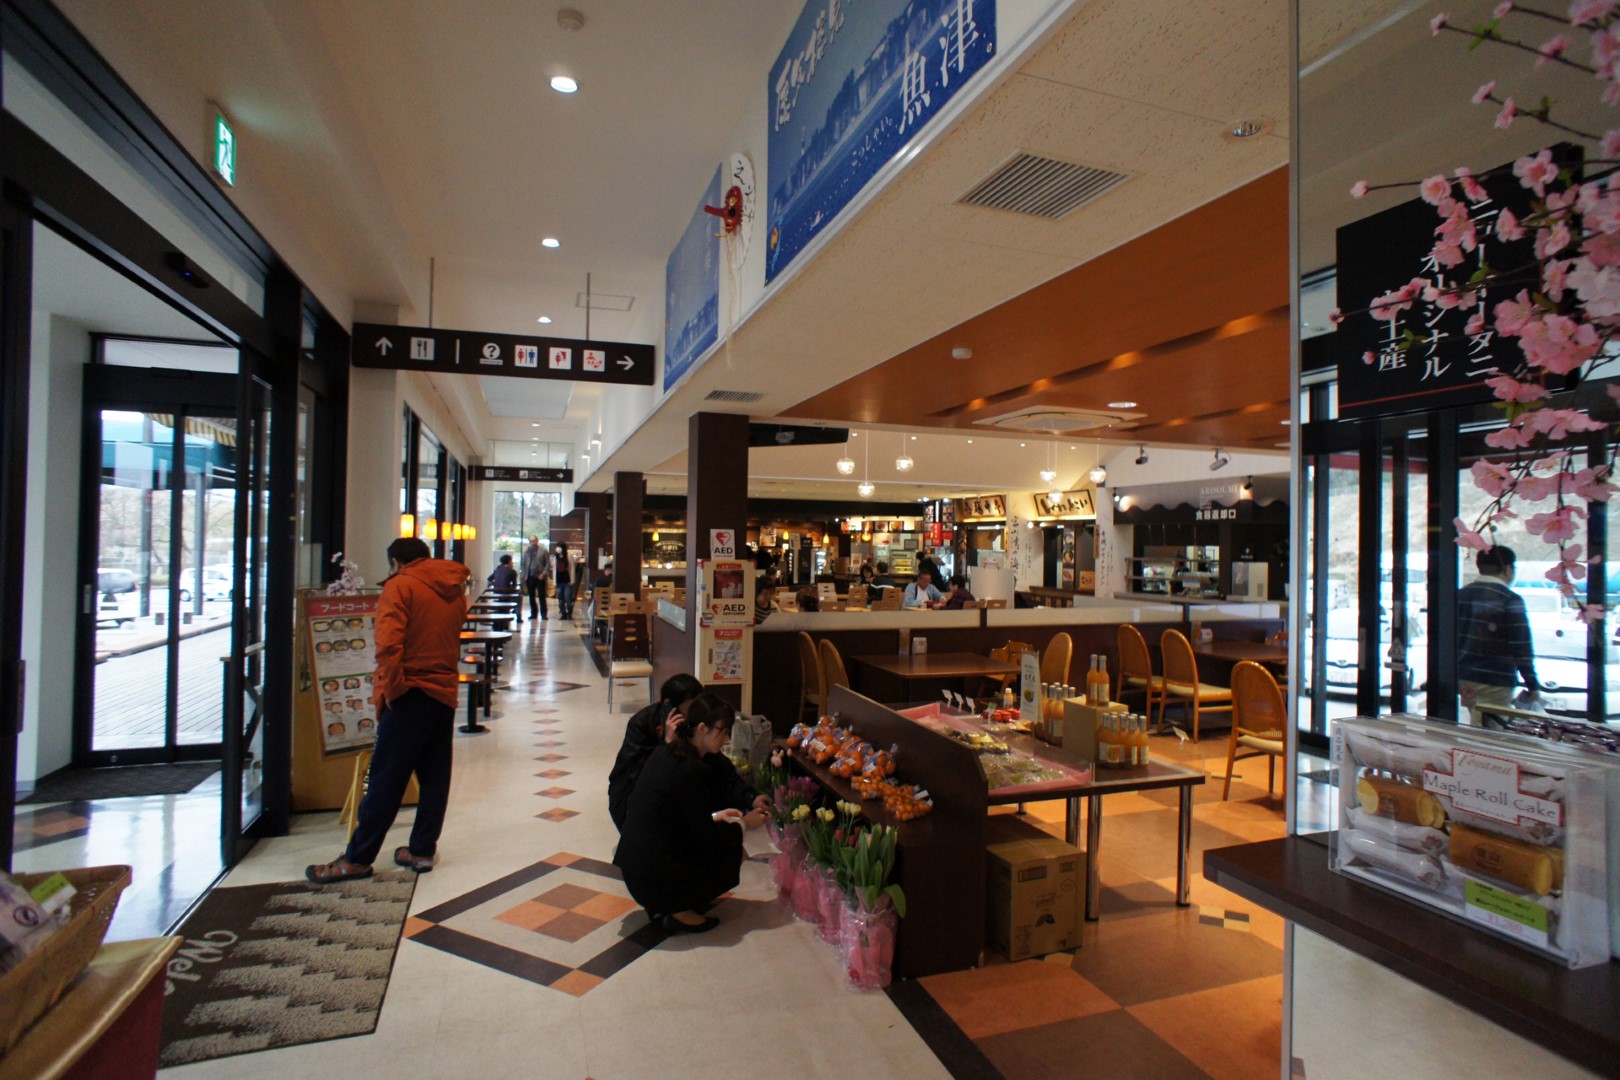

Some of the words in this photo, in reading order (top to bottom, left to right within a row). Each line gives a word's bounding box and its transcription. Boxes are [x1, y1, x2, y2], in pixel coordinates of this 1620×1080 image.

[898, 0, 979, 135] 魚津
[1465, 197, 1499, 378] ニーータニ
[320, 601, 370, 613] フードコート
[723, 604, 746, 612] AED
[1423, 772, 1470, 796] Maple
[1475, 788, 1508, 805] Roll
[1512, 798, 1556, 819] Cake
[164, 930, 239, 996] Wel
